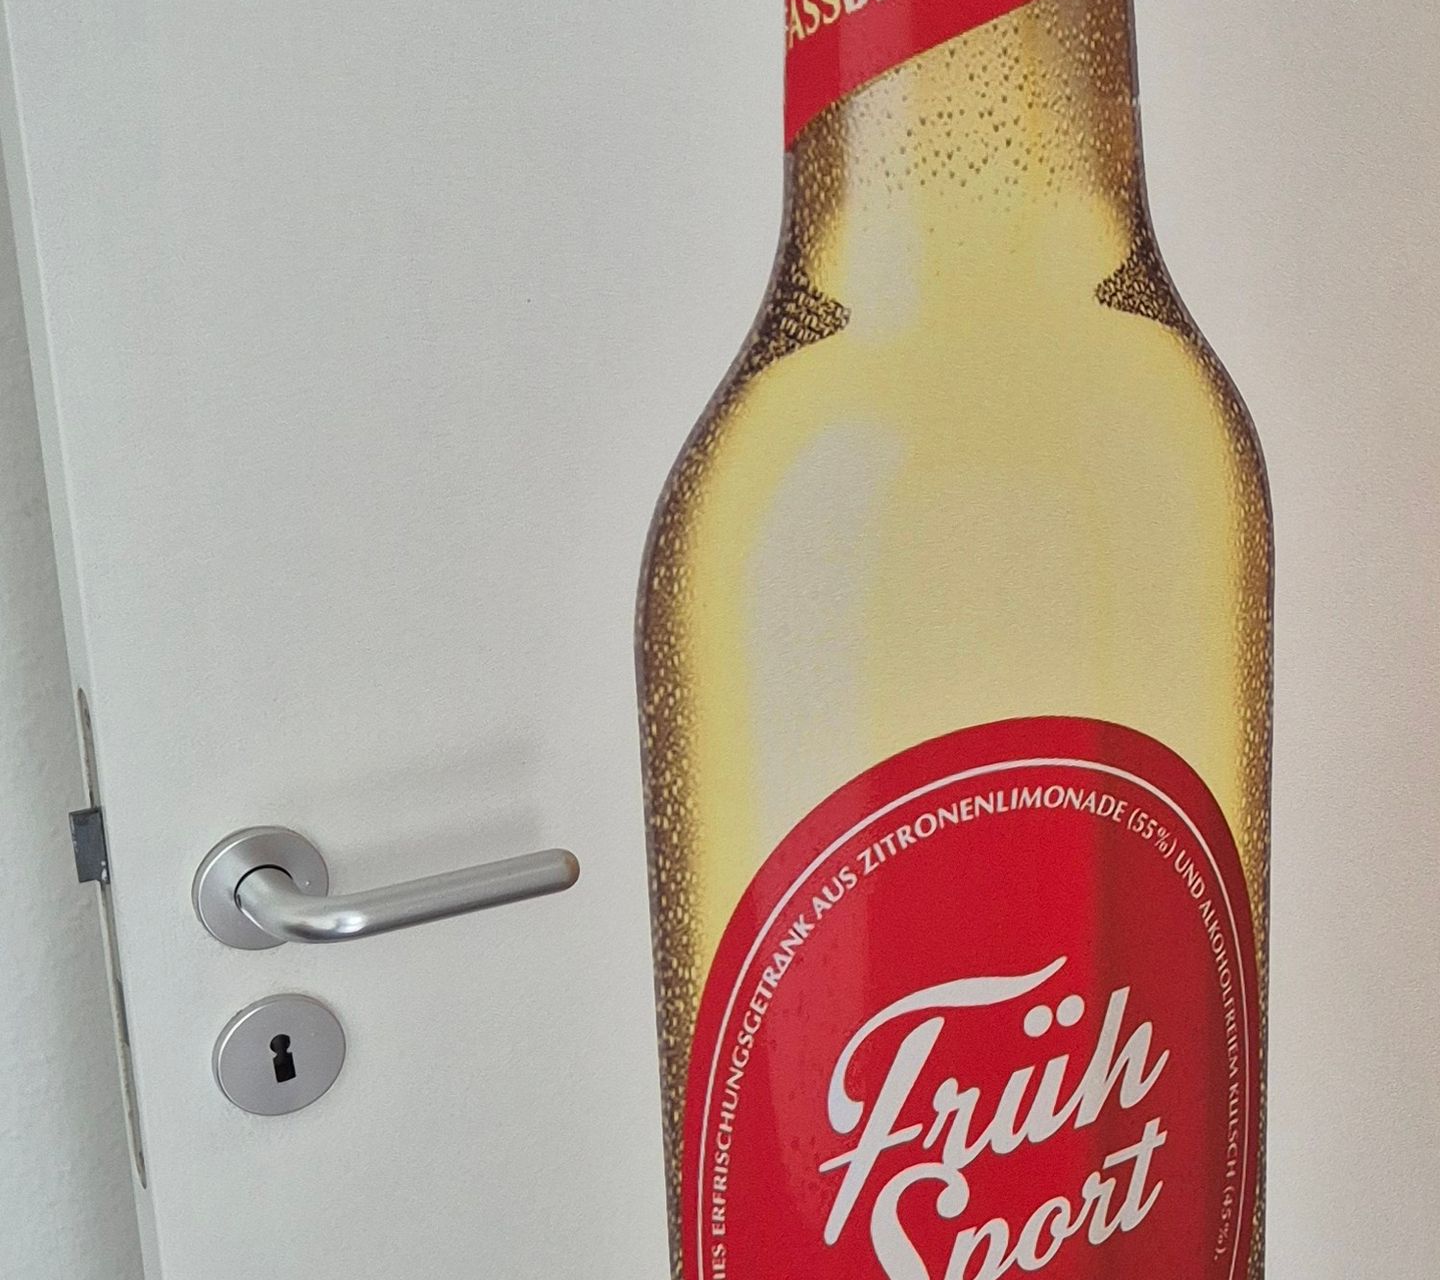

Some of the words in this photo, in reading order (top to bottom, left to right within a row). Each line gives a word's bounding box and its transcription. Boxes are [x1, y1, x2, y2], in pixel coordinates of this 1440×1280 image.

[811, 864, 859, 920] AUS
[856, 784, 1128, 877] ZITRONENLIMONADE
[1126, 807, 1179, 860] (55%)
[1173, 848, 1206, 900] UND
[819, 955, 1170, 1247] Früh
